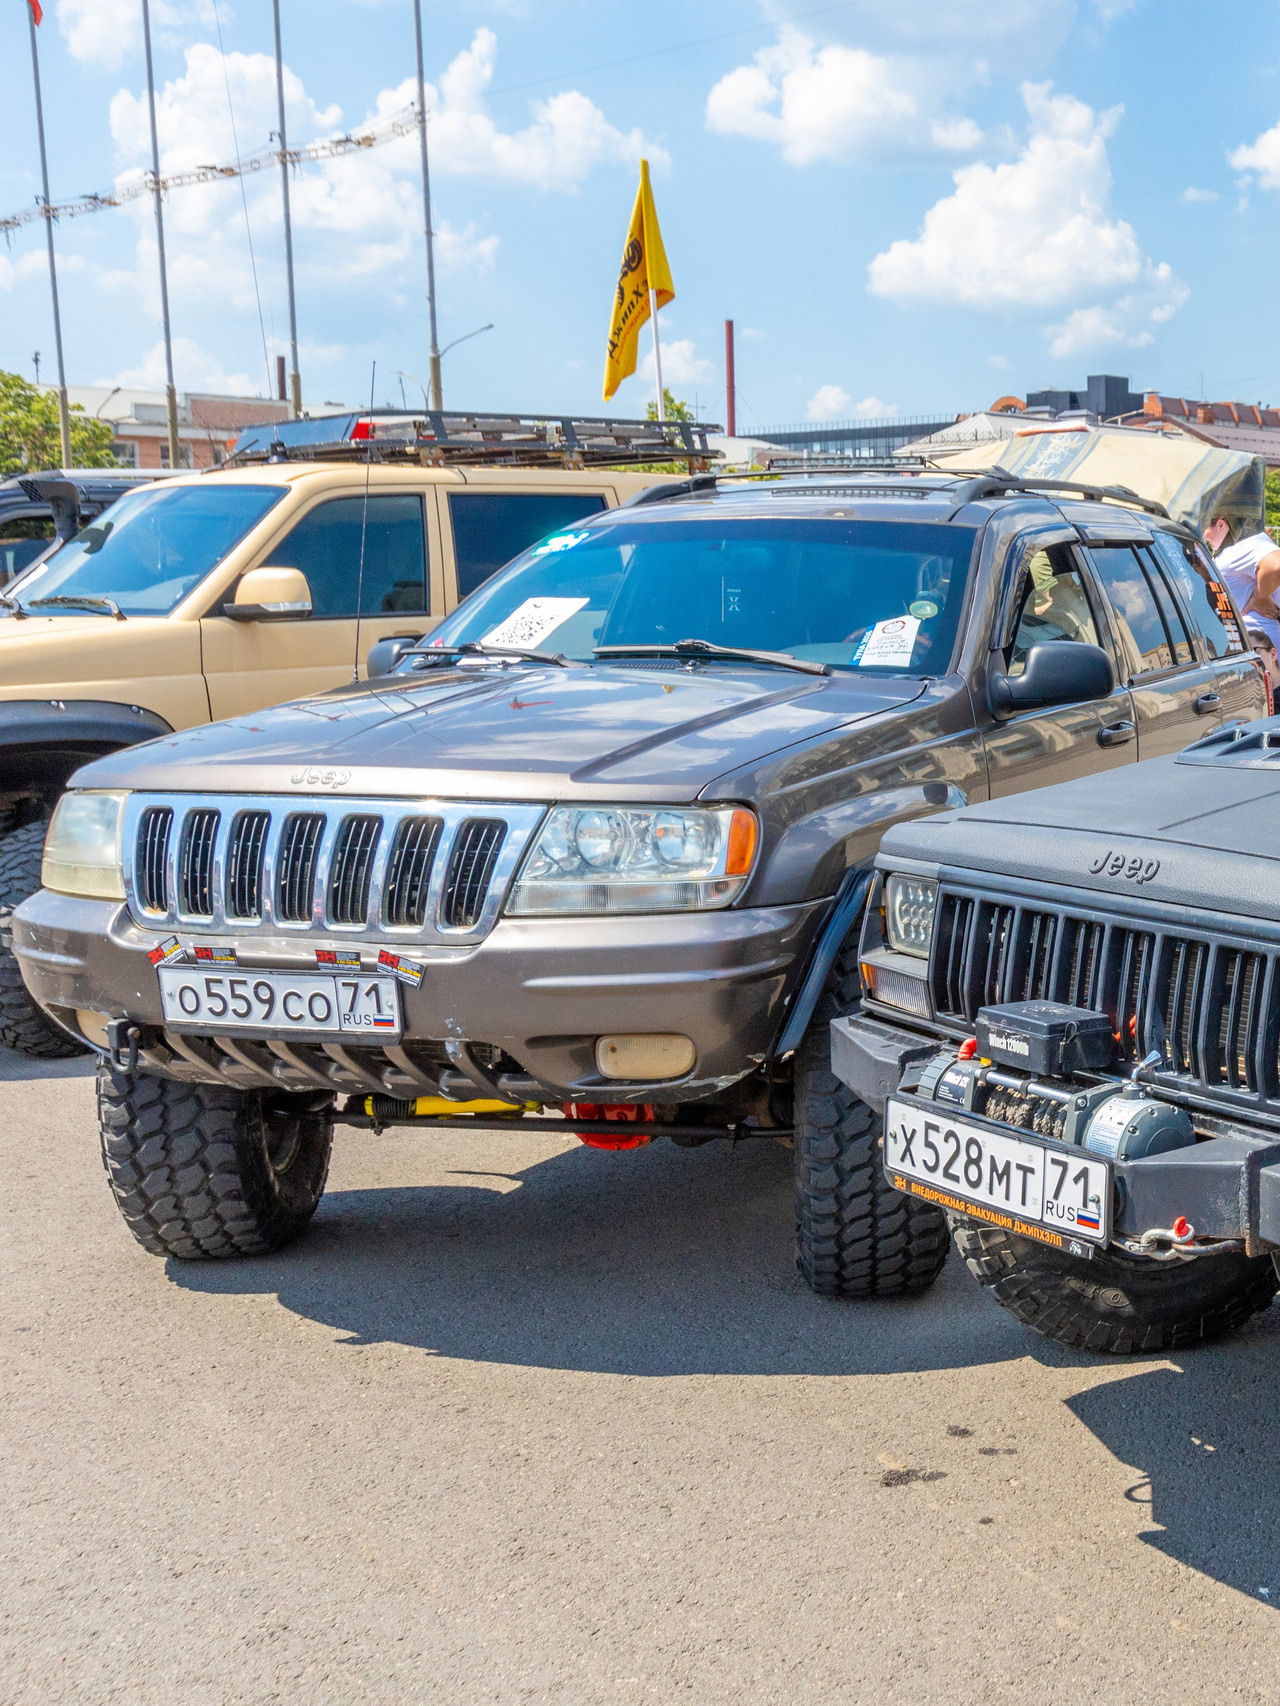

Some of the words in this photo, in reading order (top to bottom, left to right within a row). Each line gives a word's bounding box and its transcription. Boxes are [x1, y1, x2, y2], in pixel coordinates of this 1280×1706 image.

[291, 767, 351, 789] Jeep
[1089, 851, 1160, 885] Jeep
[178, 977, 332, 1022] О559СО
[342, 981, 382, 1014] 71
[343, 1014, 372, 1026] RUS
[899, 1120, 1035, 1207] Х528МТ
[1050, 1157, 1089, 1209] 71
[911, 1182, 965, 1213] ВНЕДОРОЖНАЯ
[966, 1203, 1012, 1228] ЭВАКУАЦИЯ
[1013, 1219, 1062, 1247] ДЖИПХЭЛП
[1046, 1200, 1076, 1222] RUS
